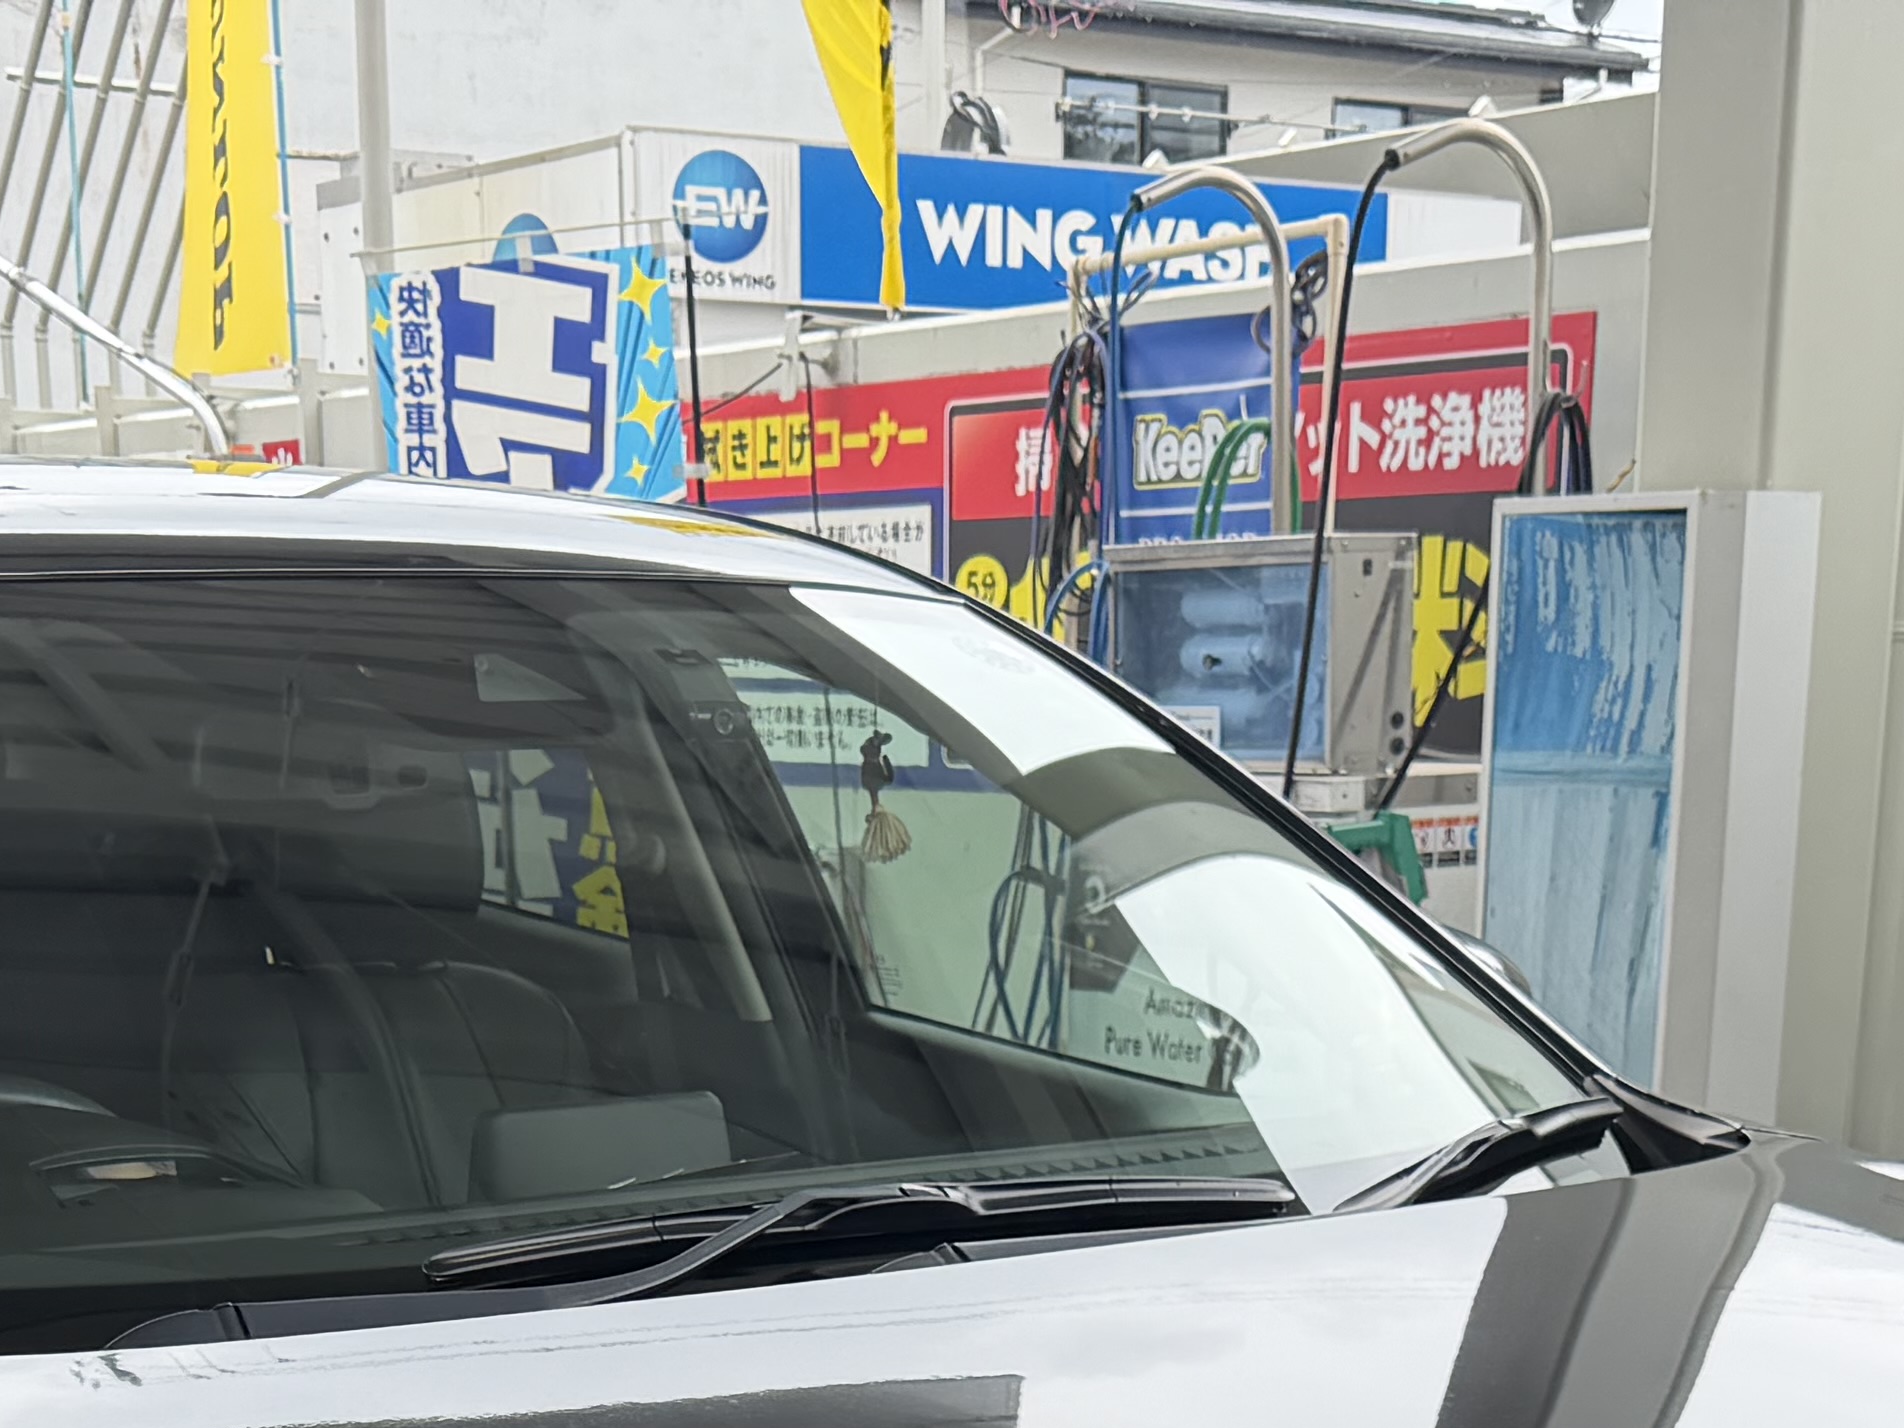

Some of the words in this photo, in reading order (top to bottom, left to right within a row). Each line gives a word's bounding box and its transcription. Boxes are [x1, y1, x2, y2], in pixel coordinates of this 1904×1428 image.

[915, 198, 1104, 273] WING
[669, 268, 727, 288] EEOS
[1104, 1025, 1143, 1057] Pure
[1146, 1029, 1203, 1064] Water
